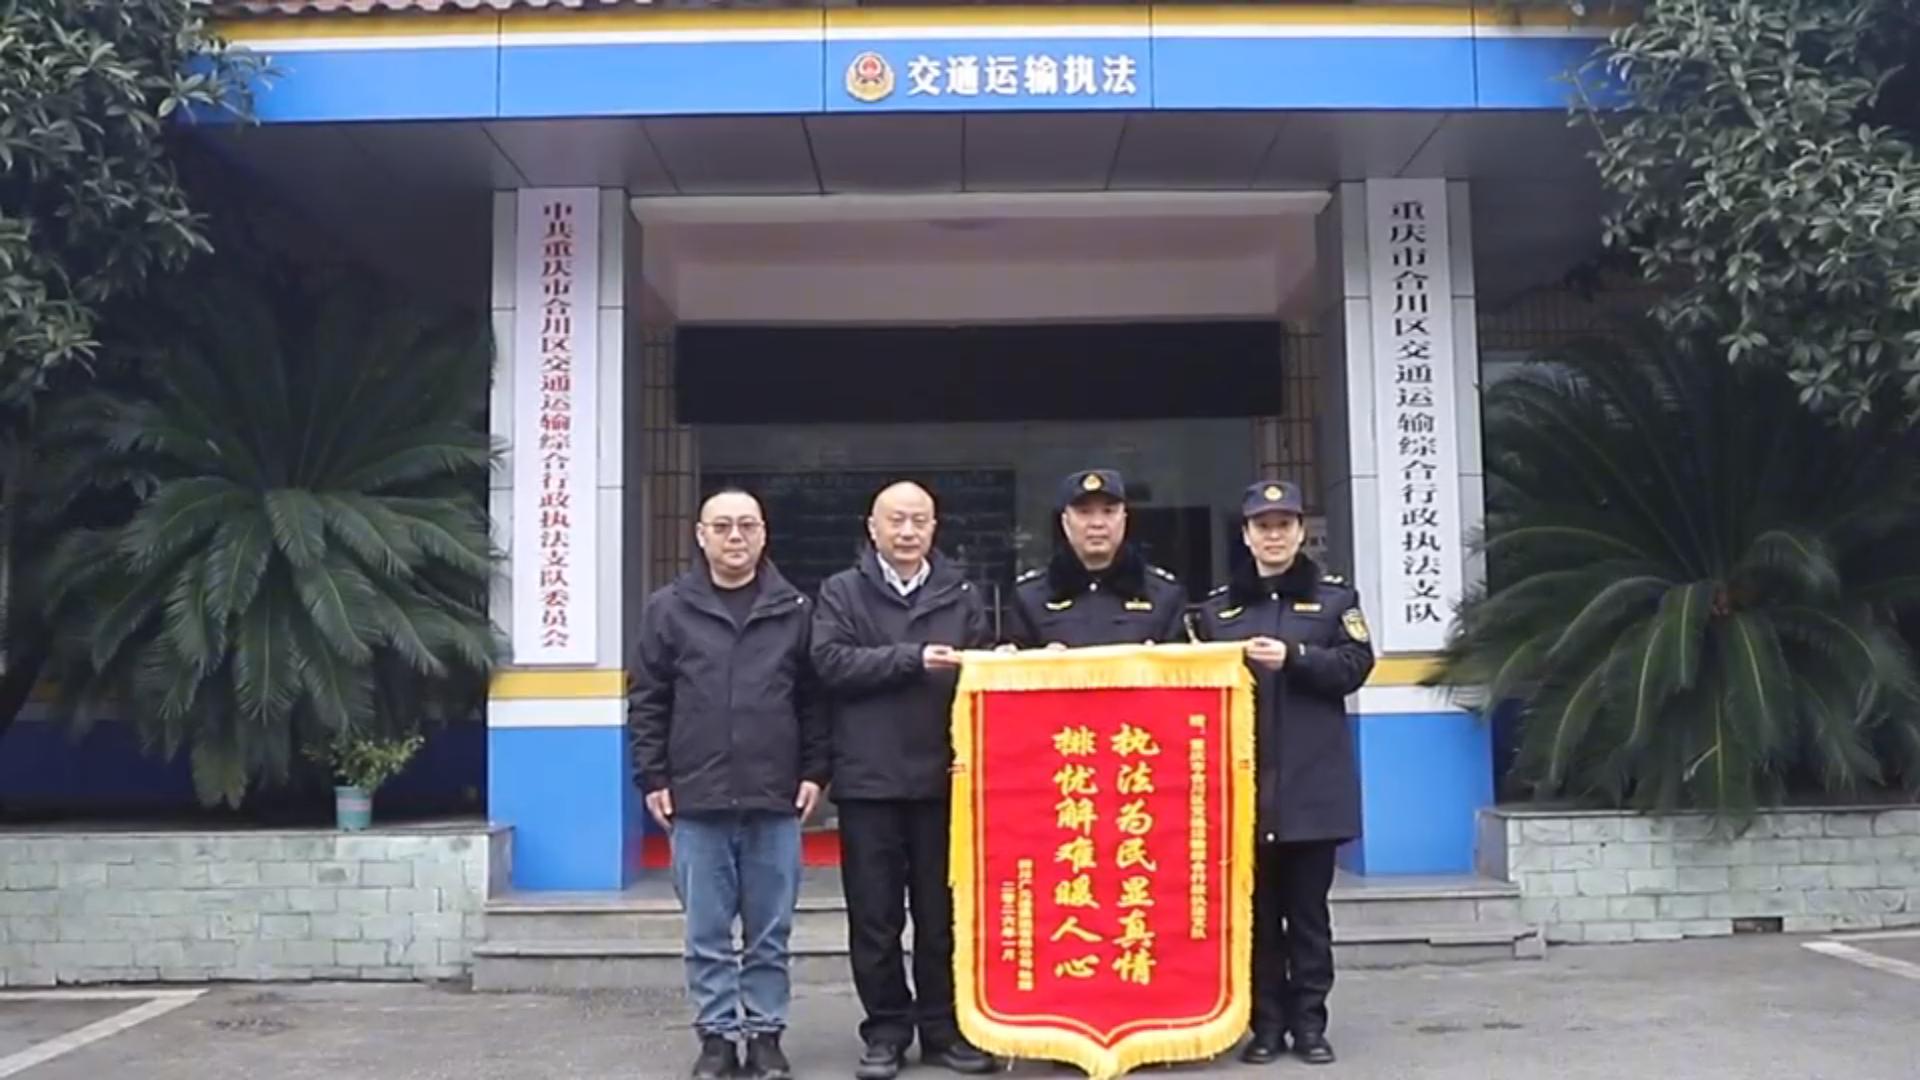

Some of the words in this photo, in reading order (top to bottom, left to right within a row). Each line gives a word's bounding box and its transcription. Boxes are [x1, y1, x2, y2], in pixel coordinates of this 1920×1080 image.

[907, 54, 1137, 95] 交通运输执法
[539, 201, 573, 648] 中共重庆市合川区交通运输综合行政执法支队委员会
[1390, 200, 1442, 623] 重庆市合川区交通运输综合行政执法支队
[1050, 725, 1104, 979] 排忧解难暖人心
[1110, 723, 1161, 986] 执法为民显真情
